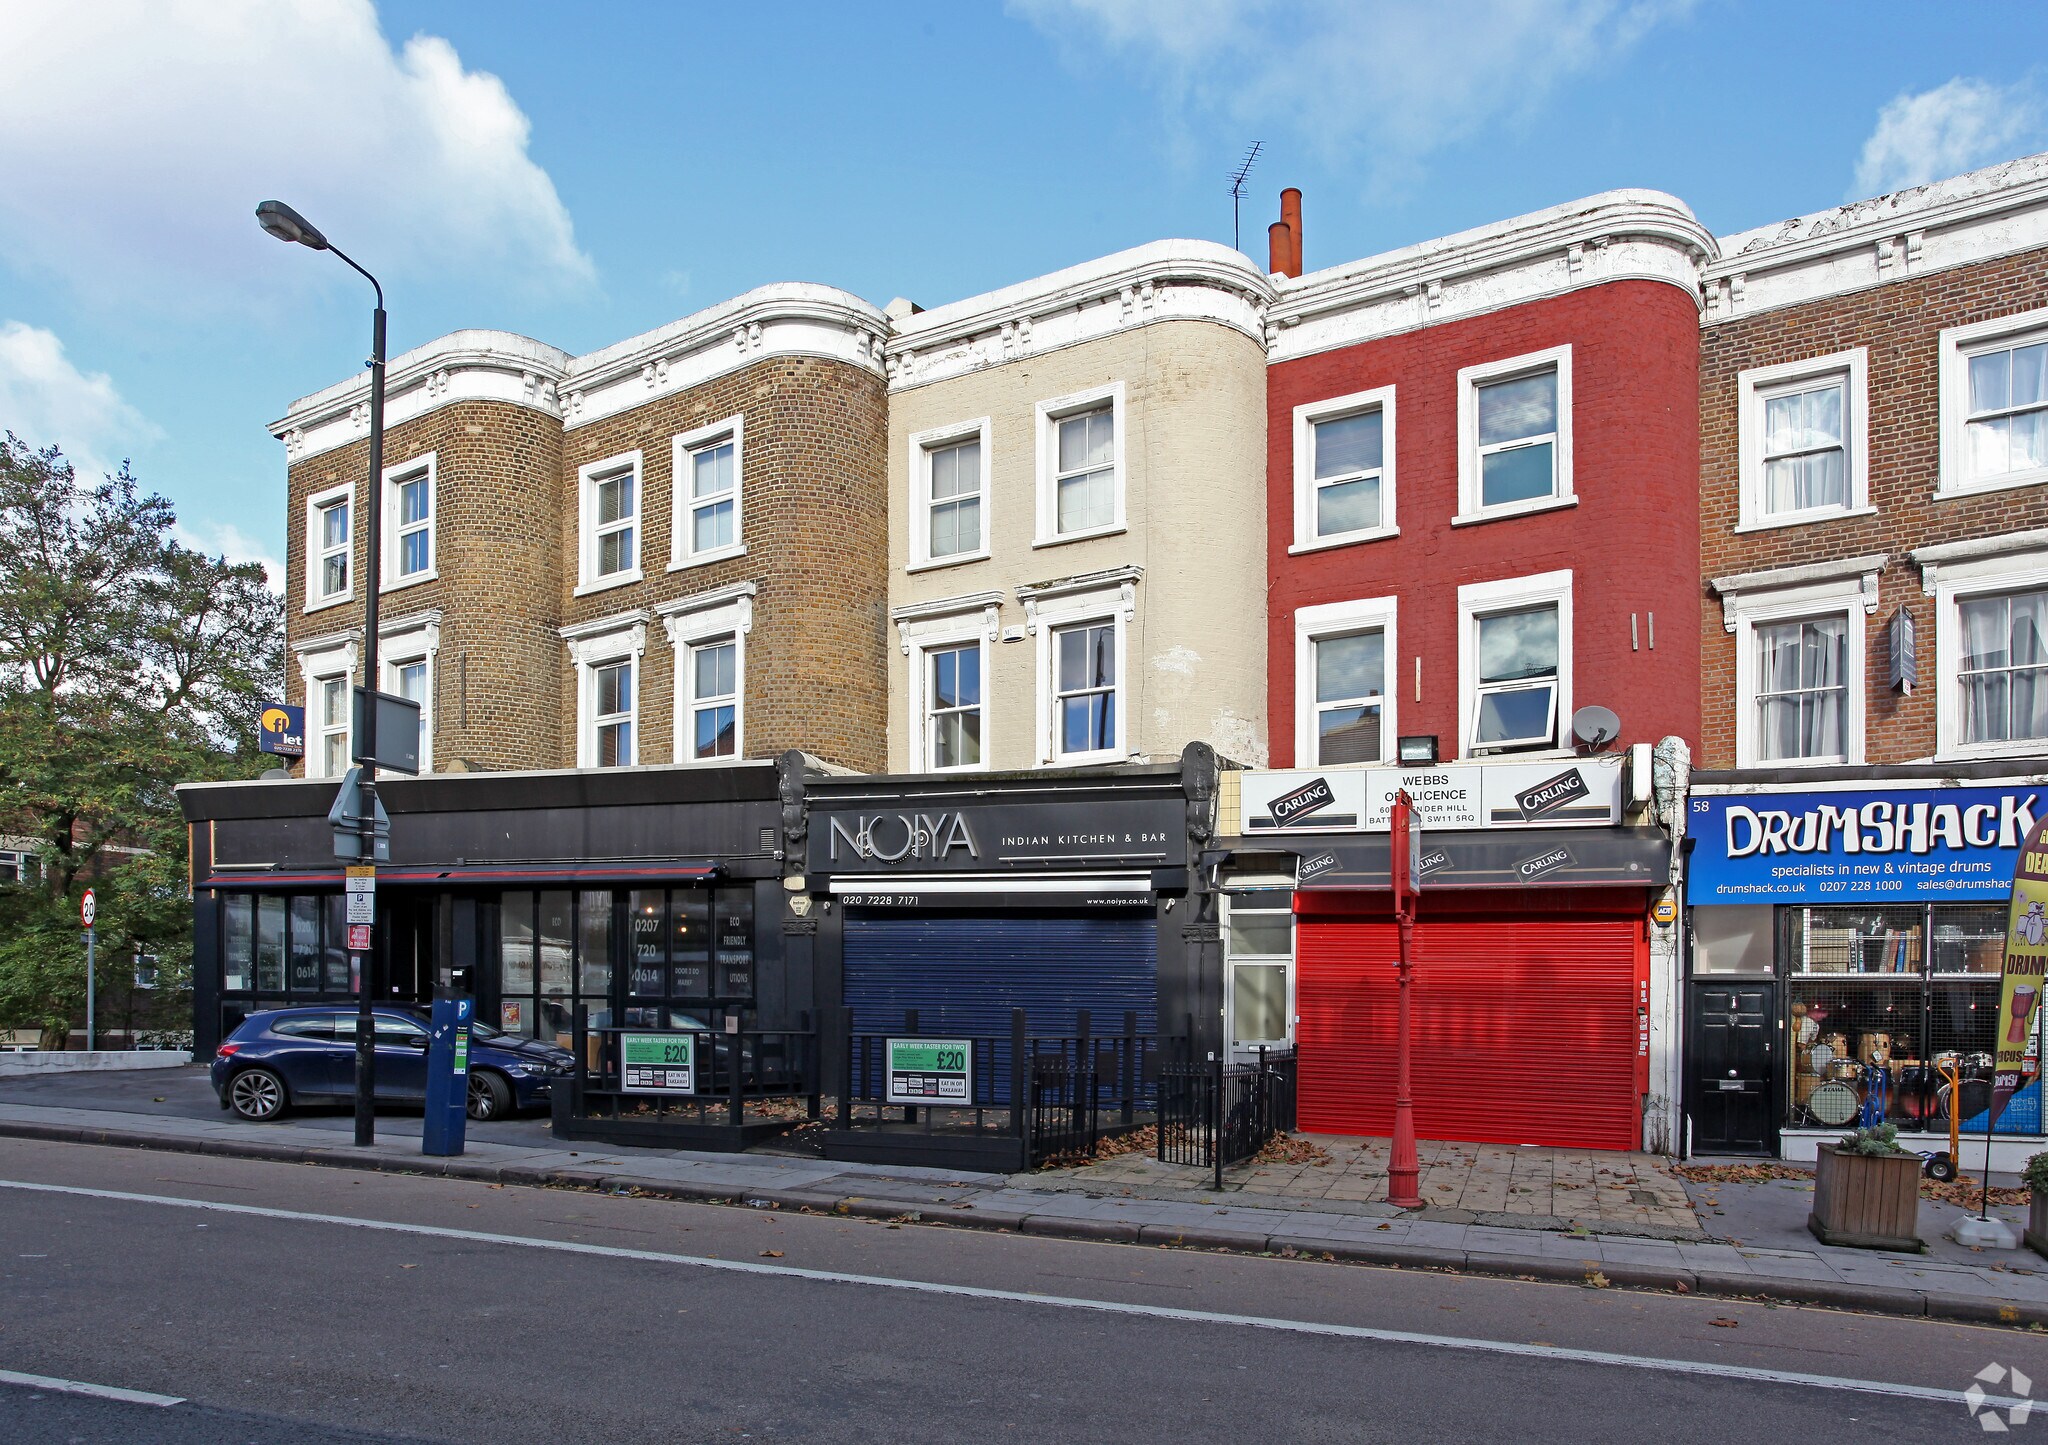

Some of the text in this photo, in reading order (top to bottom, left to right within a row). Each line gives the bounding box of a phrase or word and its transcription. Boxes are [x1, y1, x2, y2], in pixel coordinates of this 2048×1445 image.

[283, 732, 302, 745] let
[1402, 775, 1449, 786] WEBBS
[1412, 789, 1467, 801] LICENCE
[1523, 776, 1580, 810] CARLING
[1274, 785, 1328, 817] CARLING
[1692, 800, 1710, 813] 58
[1379, 806, 1390, 814] 60
[1446, 804, 1467, 812] HILL
[1427, 815, 1451, 823] SW11
[1456, 814, 1475, 822] 5RQ
[1725, 794, 2036, 857] DRUMSHACK
[830, 812, 979, 861] NOIYA
[1002, 832, 1166, 846] INDIAN KITCHEN & BAR
[1521, 850, 1568, 875] CARLING
[1771, 860, 1991, 879] specialists in new & vintage drums
[1716, 878, 2014, 895] drumshack.co.uk 0207 228 1000 sales@drumshac
[842, 895, 918, 905] 020 7228 7171
[1086, 897, 1148, 906] www.noiya.co.uk
[84, 902, 94, 917] 20
[634, 918, 659, 932] 0207
[729, 916, 740, 926] ECO
[723, 935, 747, 946] FRIENDLY
[637, 944, 656, 957] 720
[720, 954, 749, 965] TRANSPORT
[296, 966, 316, 979] 0614
[634, 968, 658, 982] 0614
[459, 1001, 467, 1017] P
[664, 1044, 688, 1063] £20
[937, 1051, 964, 1070] £20
